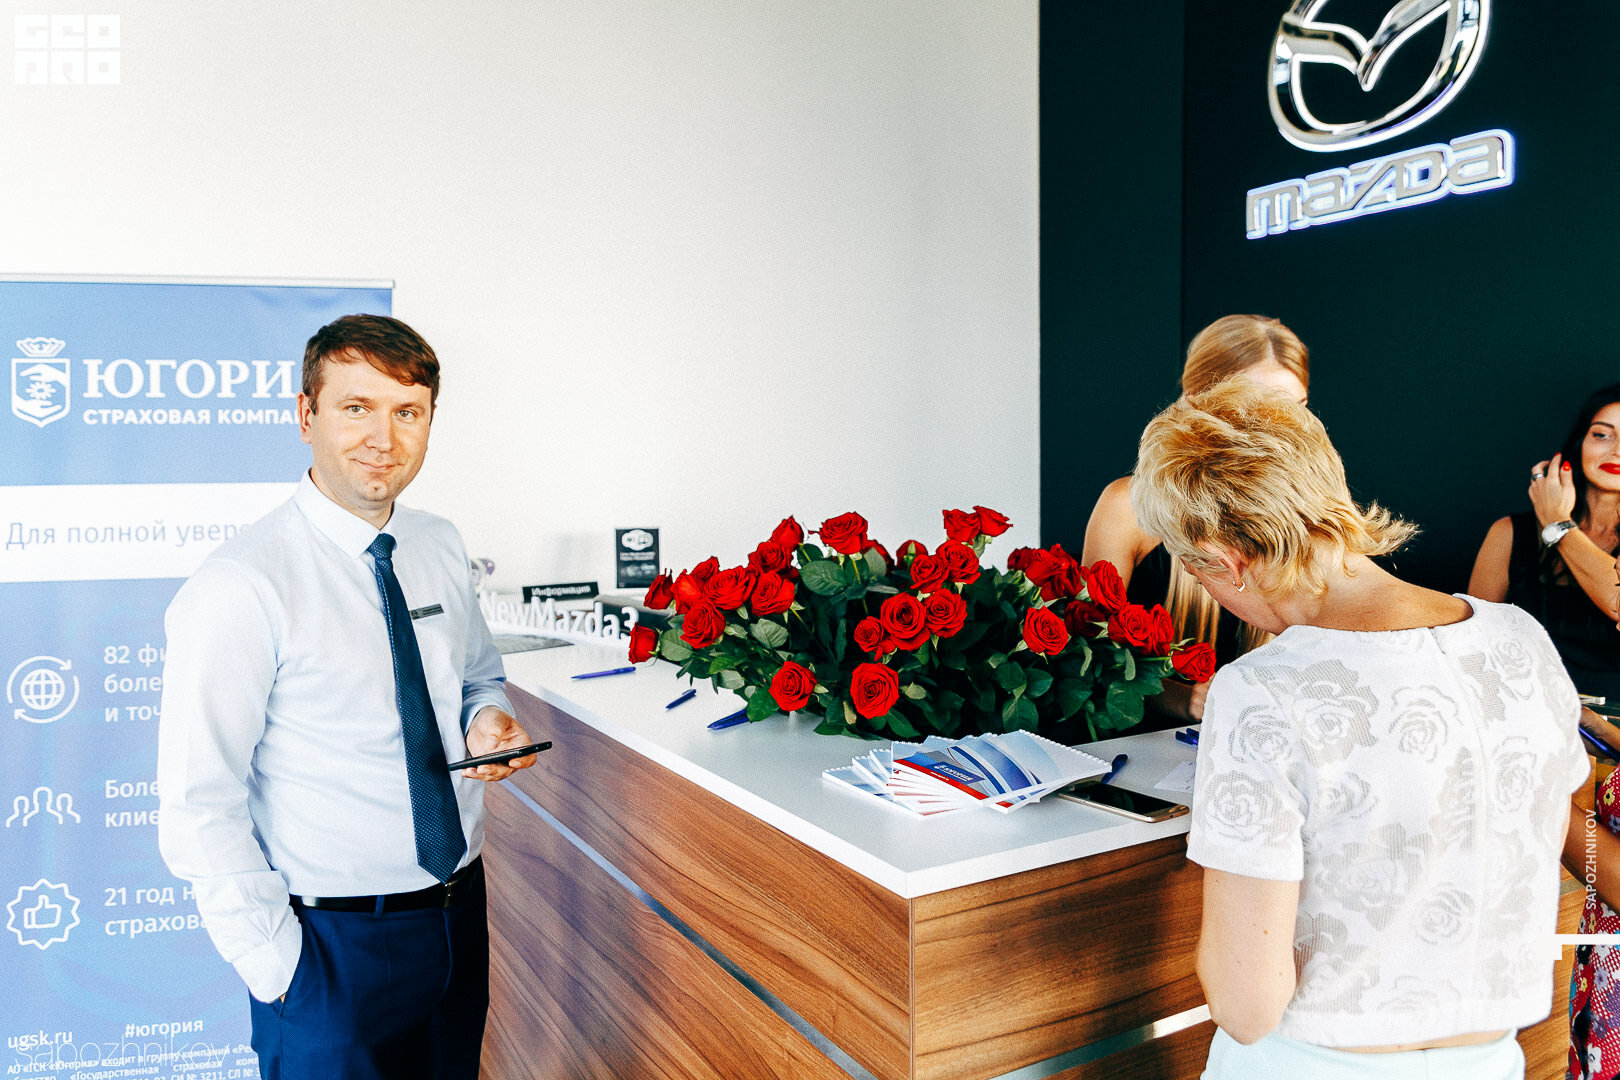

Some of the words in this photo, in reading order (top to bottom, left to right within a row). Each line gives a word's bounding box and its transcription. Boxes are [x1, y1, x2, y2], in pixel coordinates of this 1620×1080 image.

[83, 409, 211, 425] СТРАХОВАЯ
[6, 522, 56, 550] Для
[67, 520, 167, 544] полной
[104, 645, 130, 665] 82
[104, 673, 162, 693] боле
[105, 707, 119, 722] и
[105, 779, 159, 799] Боле
[104, 887, 127, 906] 21
[136, 887, 175, 906] год
[125, 1020, 203, 1037] #югория
[8, 1030, 73, 1051] ugsk.ru
